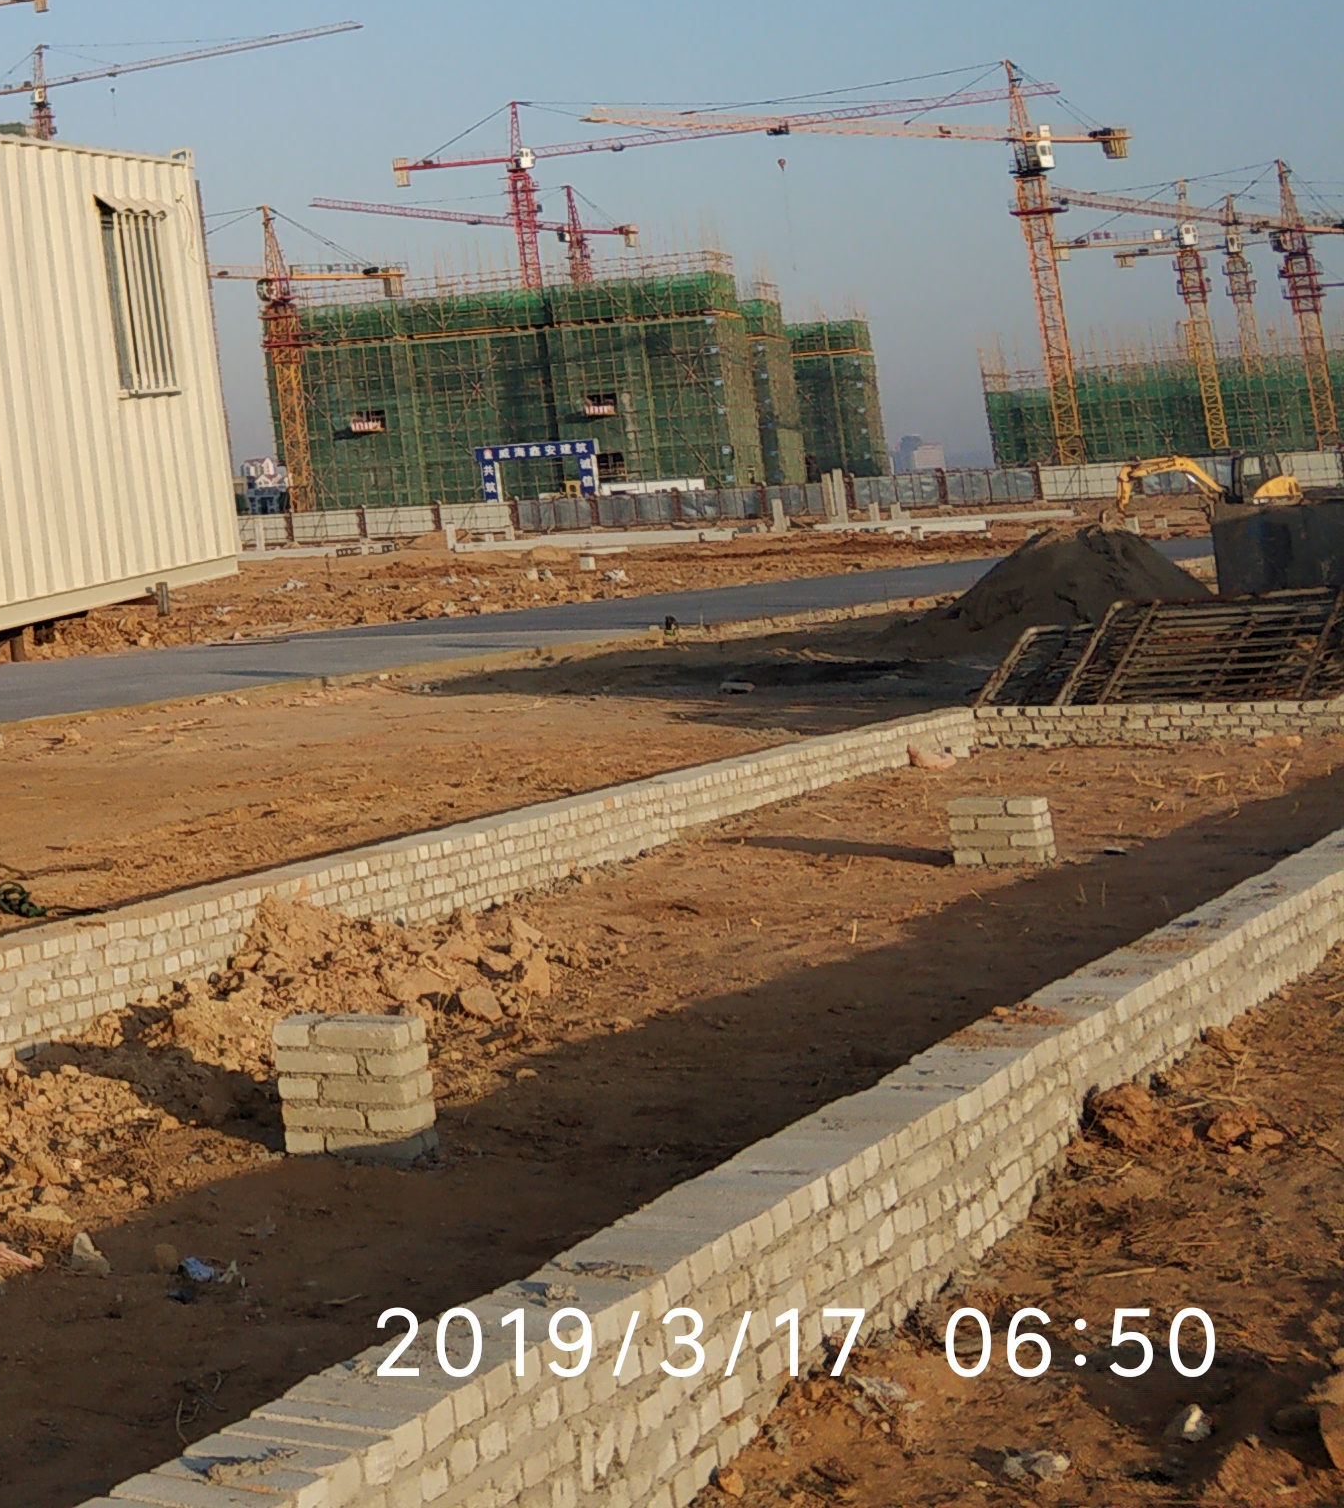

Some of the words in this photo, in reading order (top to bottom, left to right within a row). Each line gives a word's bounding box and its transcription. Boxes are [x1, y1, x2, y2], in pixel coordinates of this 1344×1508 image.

[498, 442, 588, 459] 威海鑫安建筑
